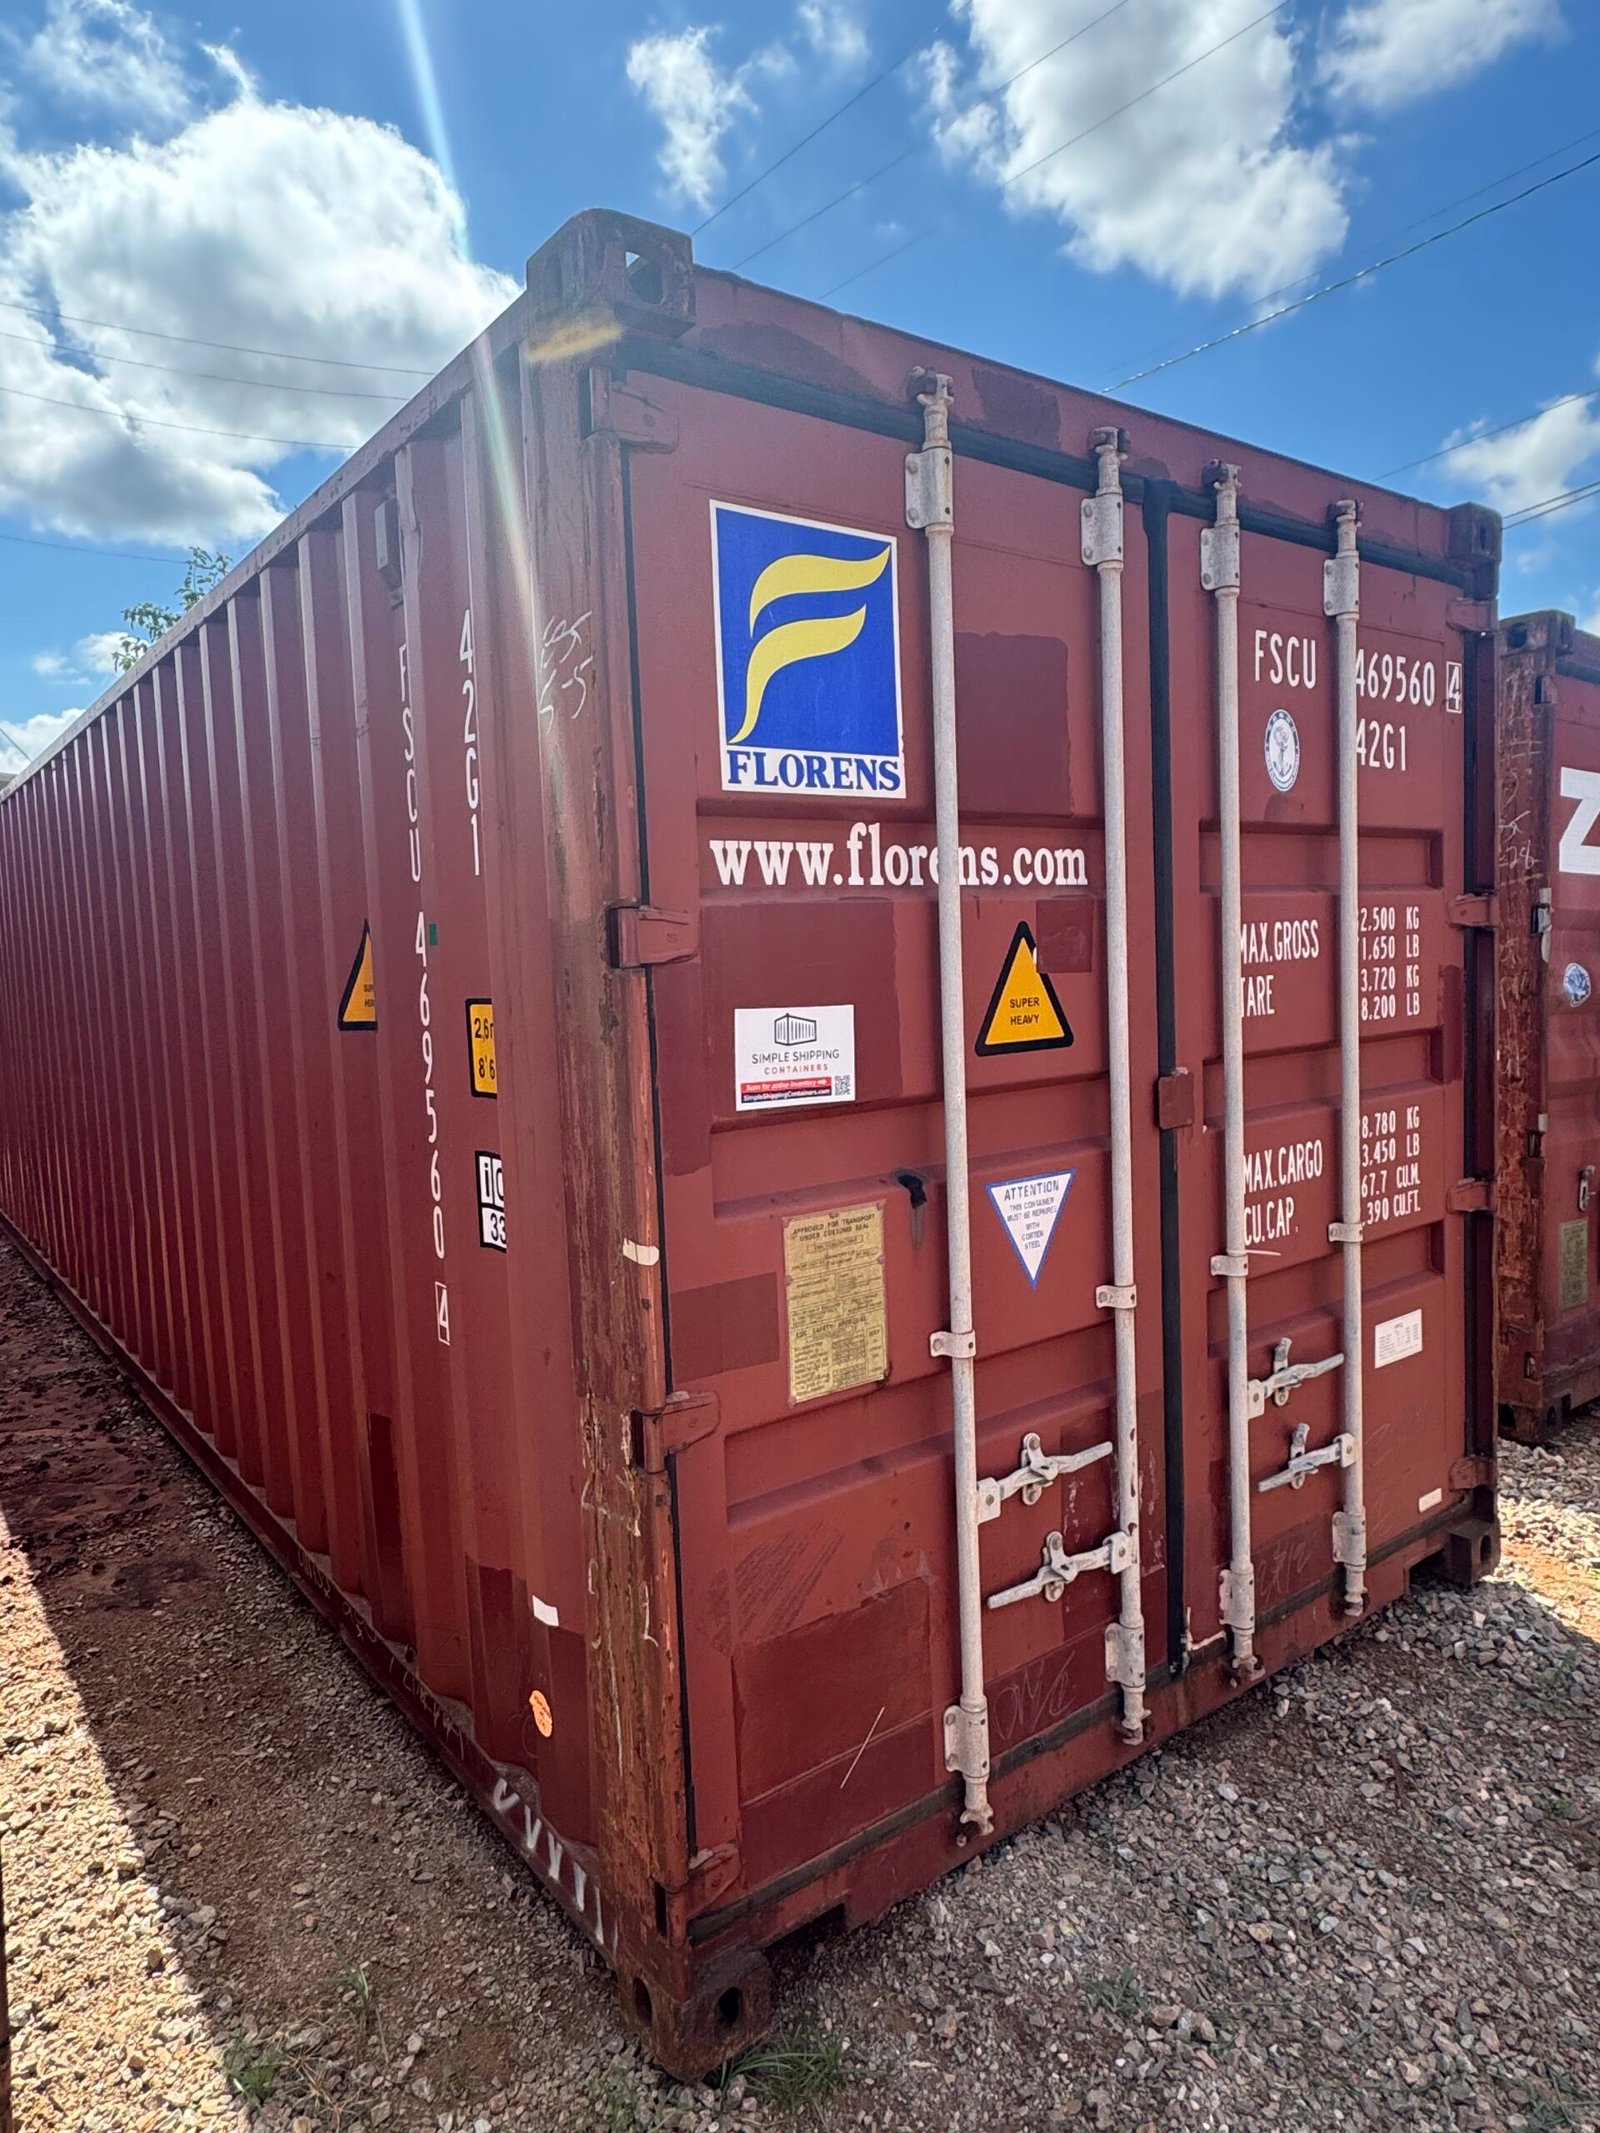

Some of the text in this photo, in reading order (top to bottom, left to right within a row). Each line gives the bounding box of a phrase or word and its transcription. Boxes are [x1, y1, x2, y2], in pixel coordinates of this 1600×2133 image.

[1255, 629, 1461, 711] FSCU 469560 4
[459, 609, 480, 876] 42G1
[1355, 718, 1406, 771] 42G1
[727, 749, 900, 792] FLORENS
[1240, 919, 1320, 965] MAX.GROSS
[1406, 906, 1420, 930] KG
[1406, 934, 1420, 958] LB
[1406, 964, 1420, 988] KG
[1009, 997, 1040, 1009] SUPER
[1406, 992, 1420, 1017] LB
[1010, 1014, 1040, 1026] HEAVY
[752, 1048, 840, 1065] SIMPLE SHIPPING
[764, 1063, 829, 1075] CONTAINERS
[1243, 1139, 1323, 1195] MAX.CARGO
[1407, 1106, 1420, 1130] KG
[1407, 1133, 1420, 1157] LB
[1004, 1179, 1060, 1201] ATTENTION
[1023, 1196, 1055, 1210] CONTAINER
[1025, 1221, 1040, 1231] WITH
